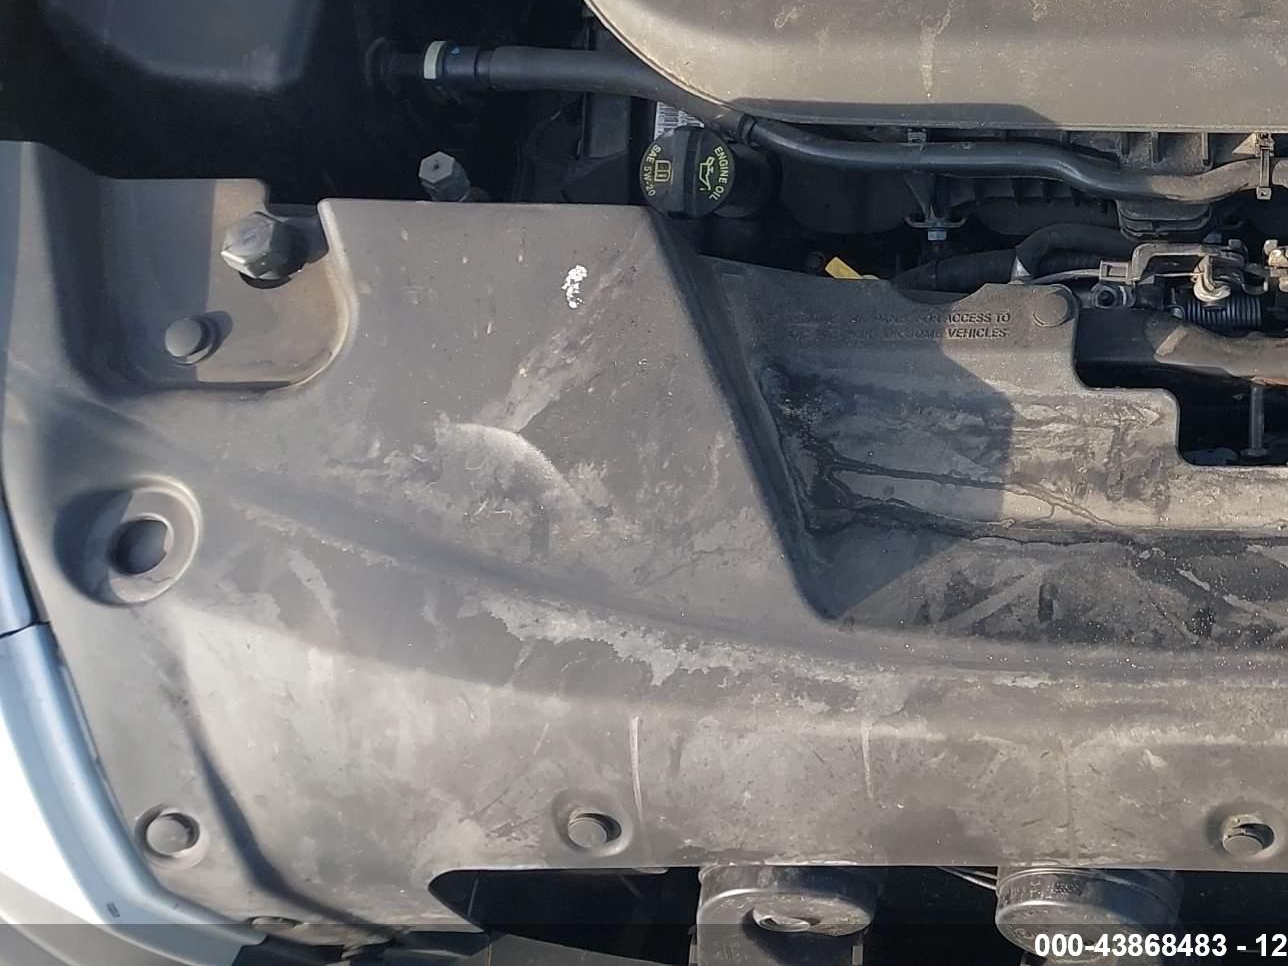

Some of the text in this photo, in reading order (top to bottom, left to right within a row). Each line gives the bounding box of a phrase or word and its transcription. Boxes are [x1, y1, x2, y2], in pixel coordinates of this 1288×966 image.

[643, 144, 661, 196] SAE 5W-20
[708, 146, 729, 201] ENGINE OIL
[944, 313, 992, 323] ACCESS
[996, 313, 1011, 323] TO
[947, 328, 1008, 339] VEHICLES
